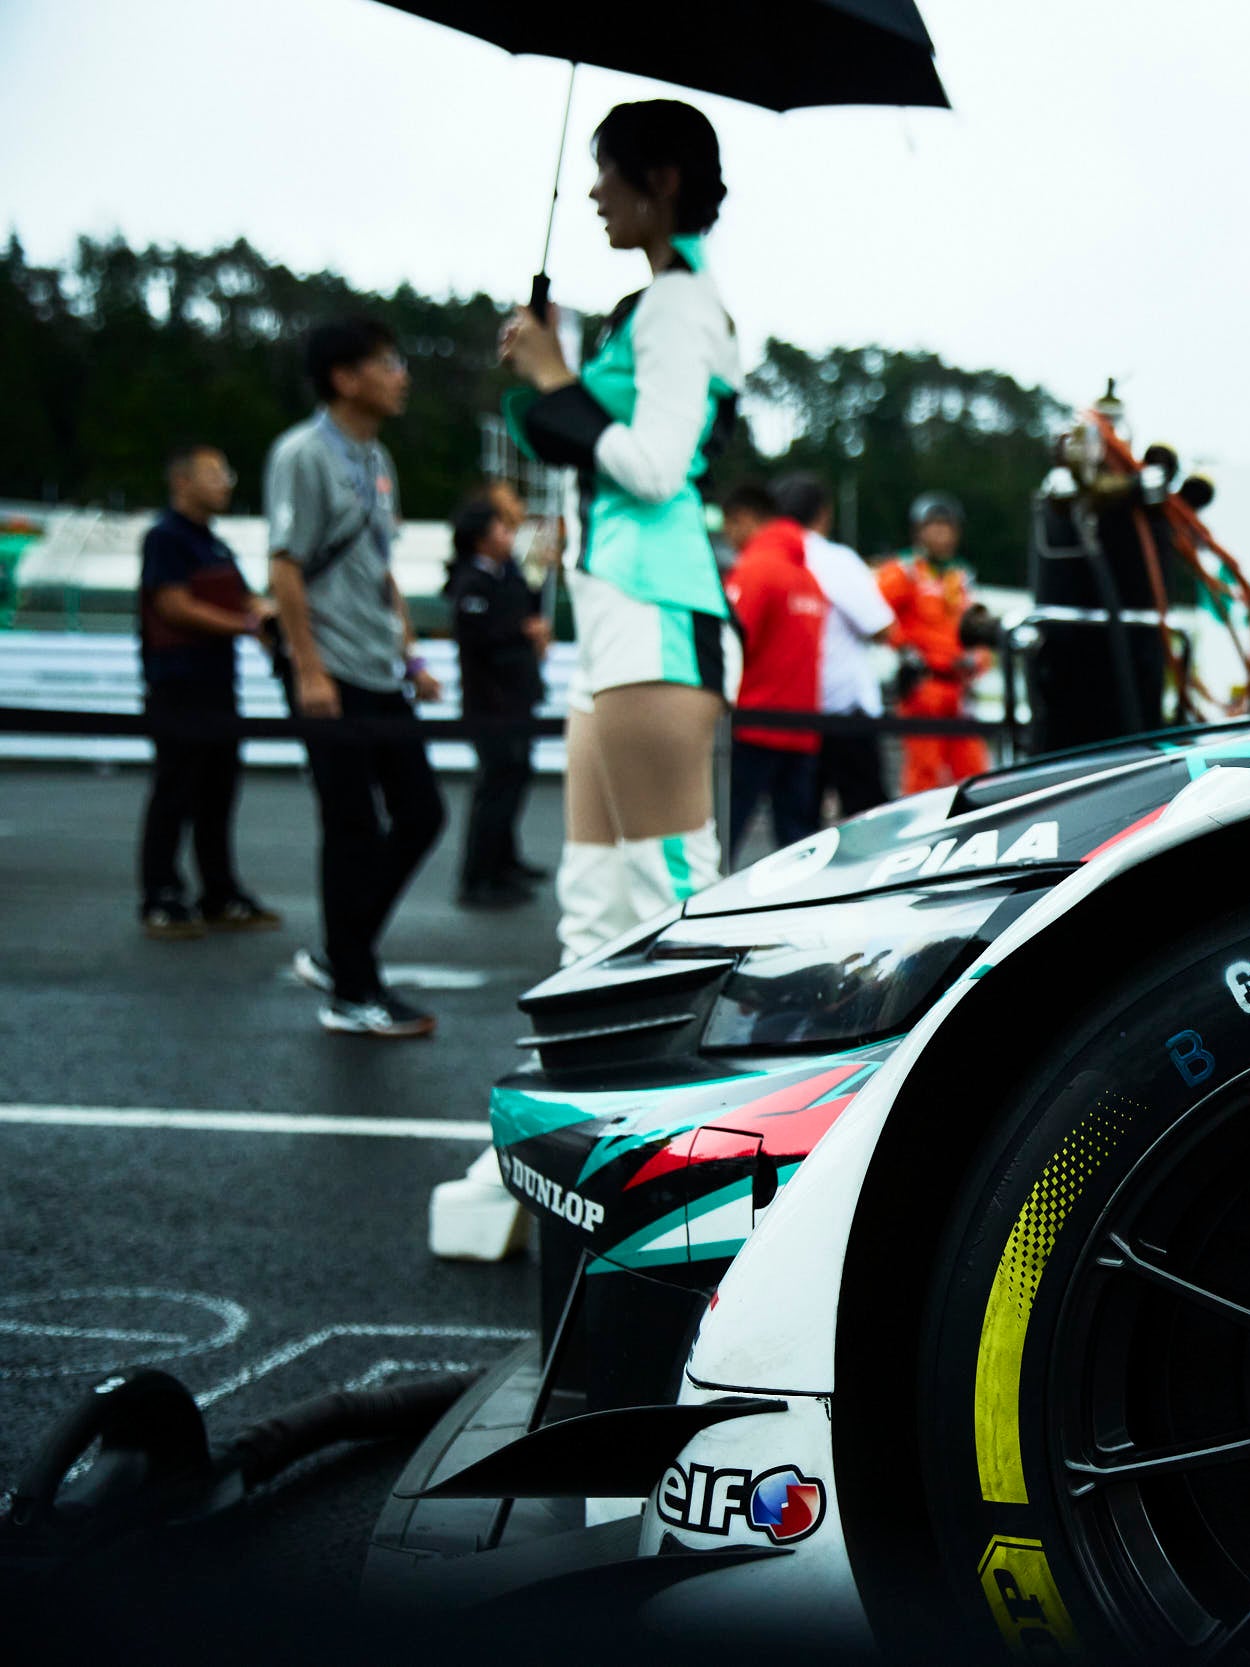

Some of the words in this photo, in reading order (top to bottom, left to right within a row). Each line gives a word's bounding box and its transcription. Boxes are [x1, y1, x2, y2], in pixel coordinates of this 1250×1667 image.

[864, 820, 1059, 888] PIAA
[1165, 1028, 1216, 1088] B
[512, 1155, 605, 1233] DUNLOP
[657, 1462, 749, 1534] elf
